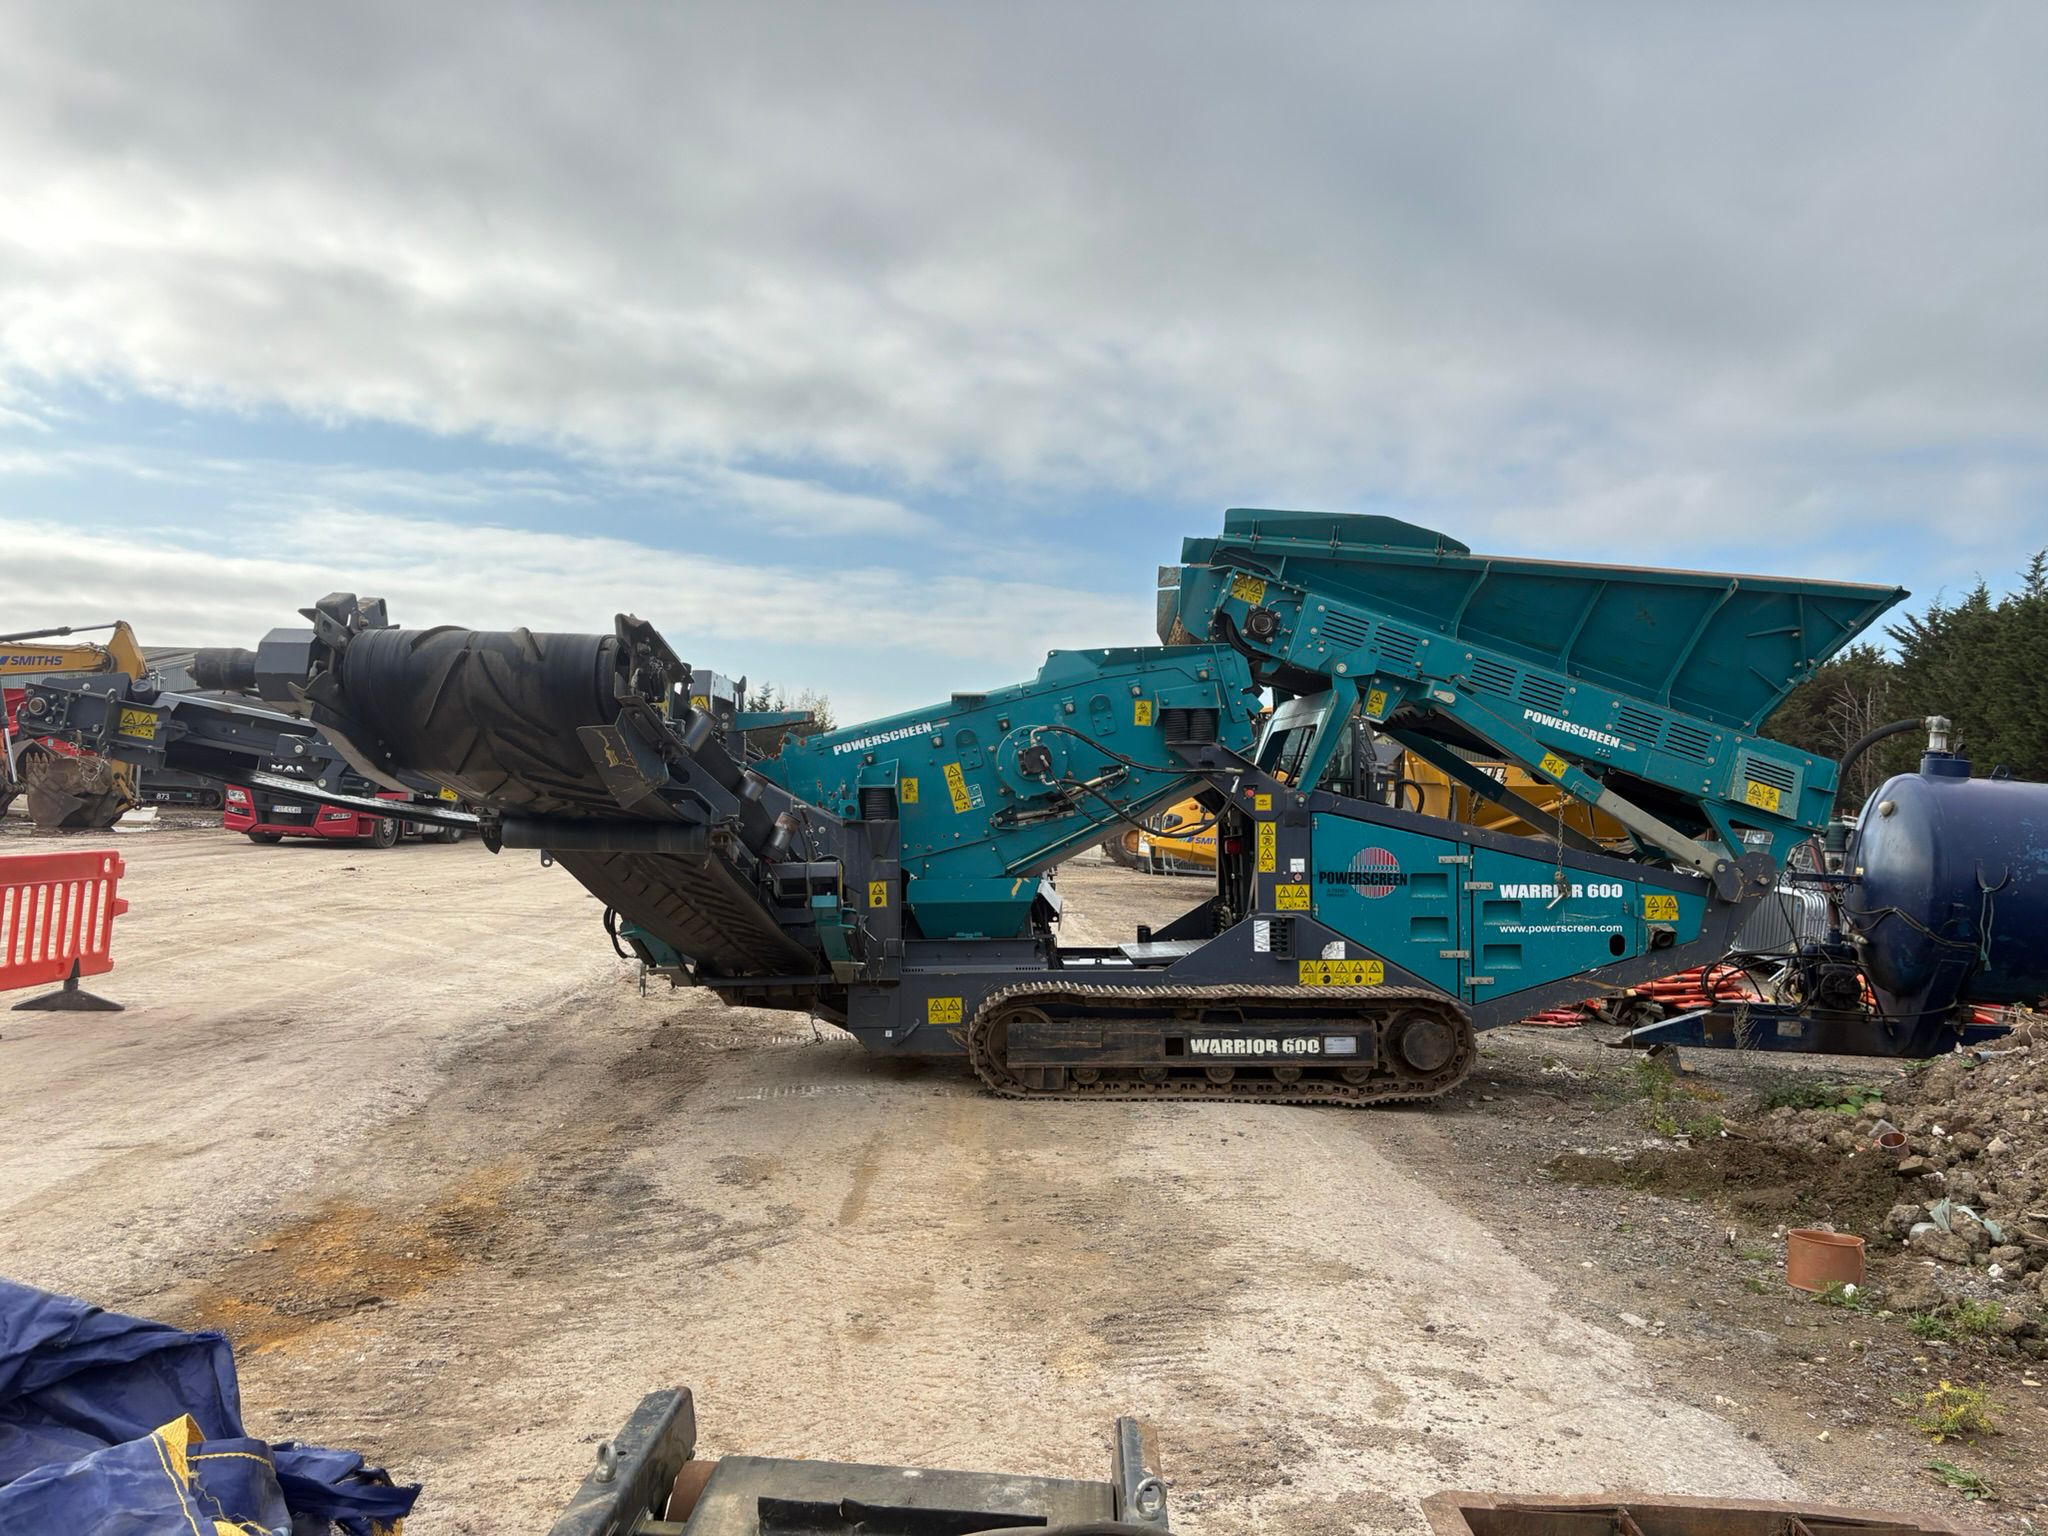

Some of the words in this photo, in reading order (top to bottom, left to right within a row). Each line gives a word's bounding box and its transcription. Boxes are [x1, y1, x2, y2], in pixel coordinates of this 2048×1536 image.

[11, 656, 63, 666] SMITHS
[1523, 708, 1620, 748] POWERSCREEN
[832, 722, 932, 756] POWERSCREEN
[156, 792, 170, 800] 873
[1319, 872, 1408, 886] POWERSCREEN
[1500, 884, 1583, 898] WARRIR
[1587, 884, 1623, 898] 600
[1500, 924, 1623, 935] www.powerscreen.com
[1190, 1039, 1278, 1053] WARRIOR
